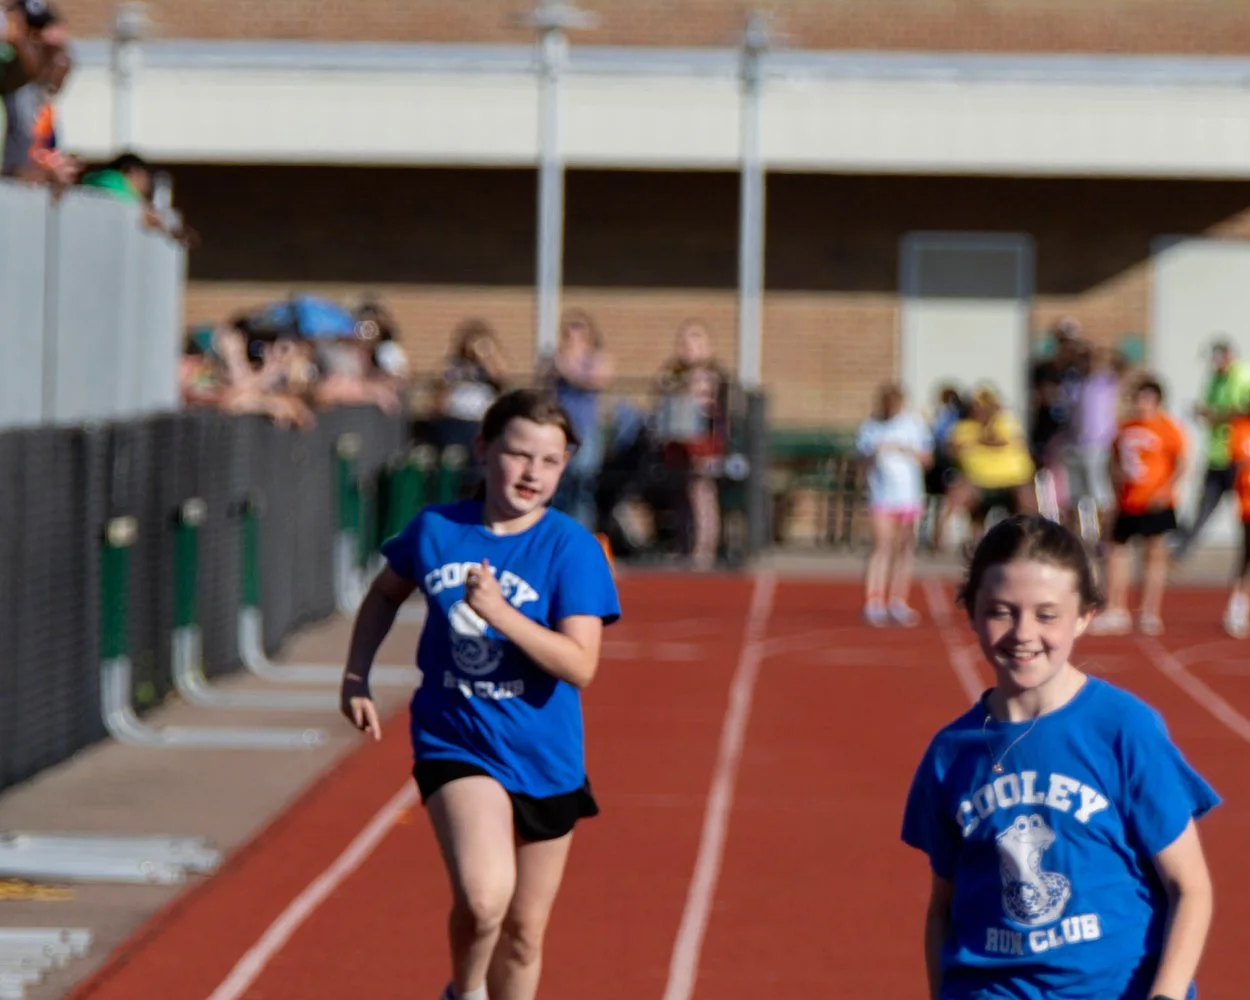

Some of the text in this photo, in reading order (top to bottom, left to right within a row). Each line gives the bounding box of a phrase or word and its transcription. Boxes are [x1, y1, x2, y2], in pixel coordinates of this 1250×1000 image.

[956, 770, 1109, 838] COOLEY
[985, 913, 1102, 955] RUN CLUB
